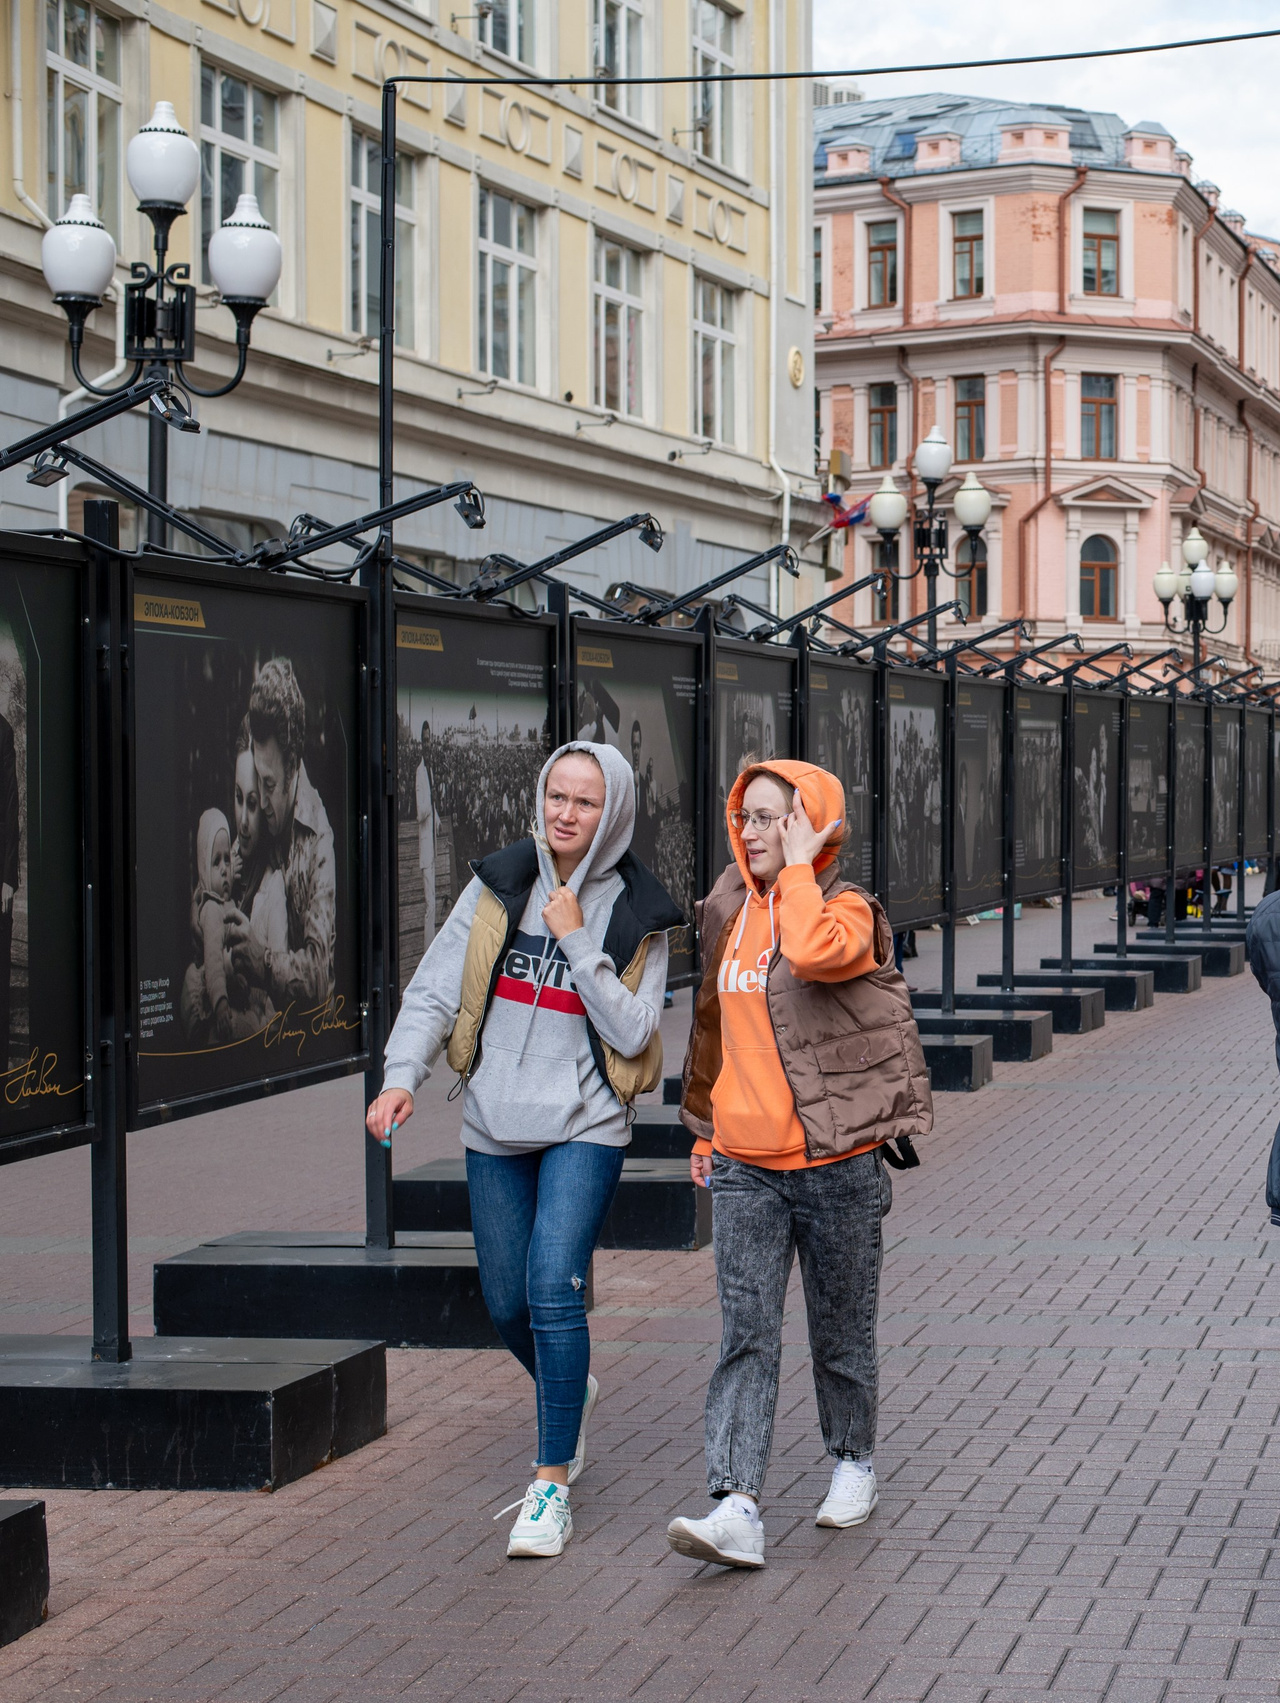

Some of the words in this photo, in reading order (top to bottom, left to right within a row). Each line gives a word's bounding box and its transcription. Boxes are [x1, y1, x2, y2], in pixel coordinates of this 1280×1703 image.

[144, 601, 199, 622] ЭПОХА-КОБЗОН
[401, 630, 439, 647] ЭПОХА-КОБЗОН
[501, 951, 578, 992] evi'
